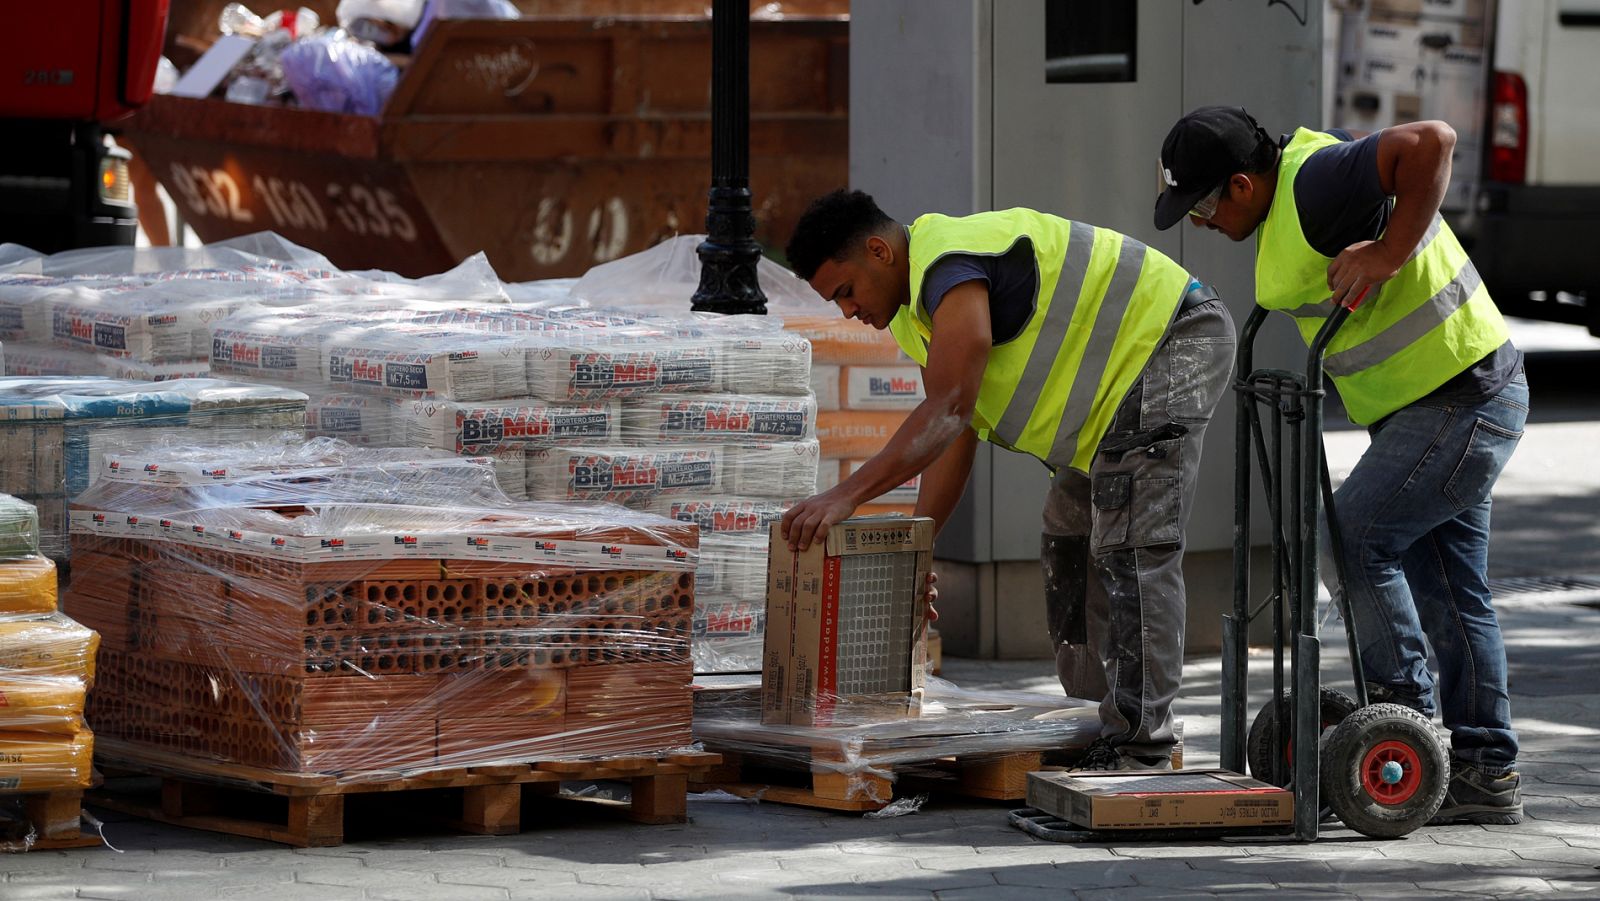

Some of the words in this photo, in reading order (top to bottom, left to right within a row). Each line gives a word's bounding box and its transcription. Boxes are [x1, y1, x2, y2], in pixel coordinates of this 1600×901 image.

[213, 338, 259, 362] BigMat
[330, 356, 383, 383] BigMat
[576, 363, 657, 387] BigMat
[869, 377, 917, 393] BigMat
[117, 405, 145, 416] Roca
[556, 416, 587, 425] MORTERO
[587, 415, 605, 424] SECO
[668, 411, 750, 433] BigMat
[756, 413, 785, 422] MORTERO
[786, 414, 802, 422] SECO
[464, 419, 550, 441] BigMat
[560, 425, 588, 436] M-7,5
[760, 422, 786, 433] M-7,5
[832, 426, 888, 438] FLEXIBLE
[664, 464, 693, 474] MORTERO
[574, 466, 658, 491] BigMat
[823, 560, 835, 697] www.todagres.com
[1147, 807, 1159, 818] BMT
[1239, 806, 1260, 817] PETRES
[1260, 806, 1280, 818] PULIDO
